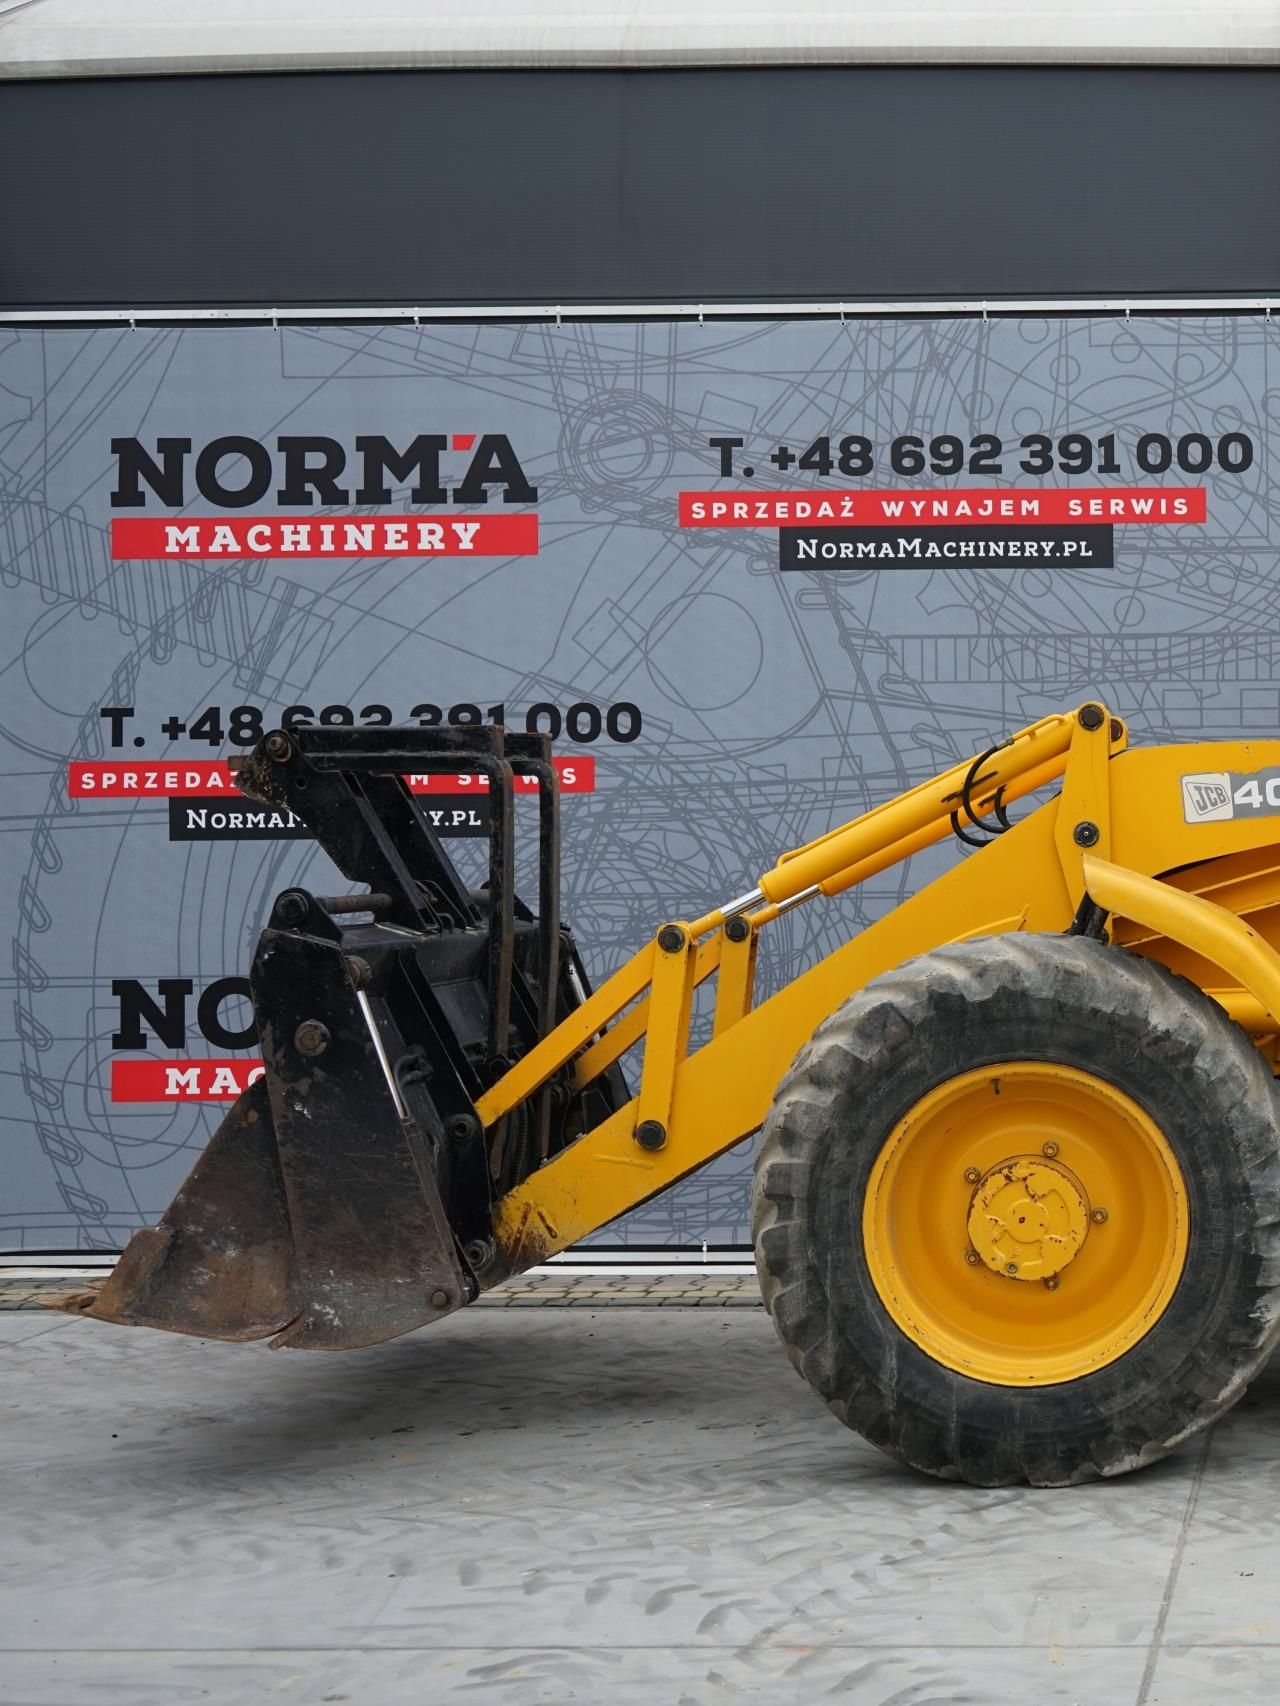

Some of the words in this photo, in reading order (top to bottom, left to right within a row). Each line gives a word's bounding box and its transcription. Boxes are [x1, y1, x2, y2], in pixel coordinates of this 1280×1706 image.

[110, 434, 538, 508] NORMA
[709, 437, 755, 478] T.
[770, 435, 874, 477] +48
[890, 433, 1003, 477] 692
[1019, 432, 1121, 475] 391
[1136, 431, 1254, 475] 000
[691, 495, 855, 519] SPRZEDAŻ
[881, 499, 1040, 518] WYNAJEM
[1067, 498, 1189, 517] SERWIS
[164, 522, 481, 553] MACHINERY
[100, 707, 146, 748] T.
[161, 704, 265, 748] +48
[525, 701, 643, 744] 000
[1193, 784, 1228, 812] JCB
